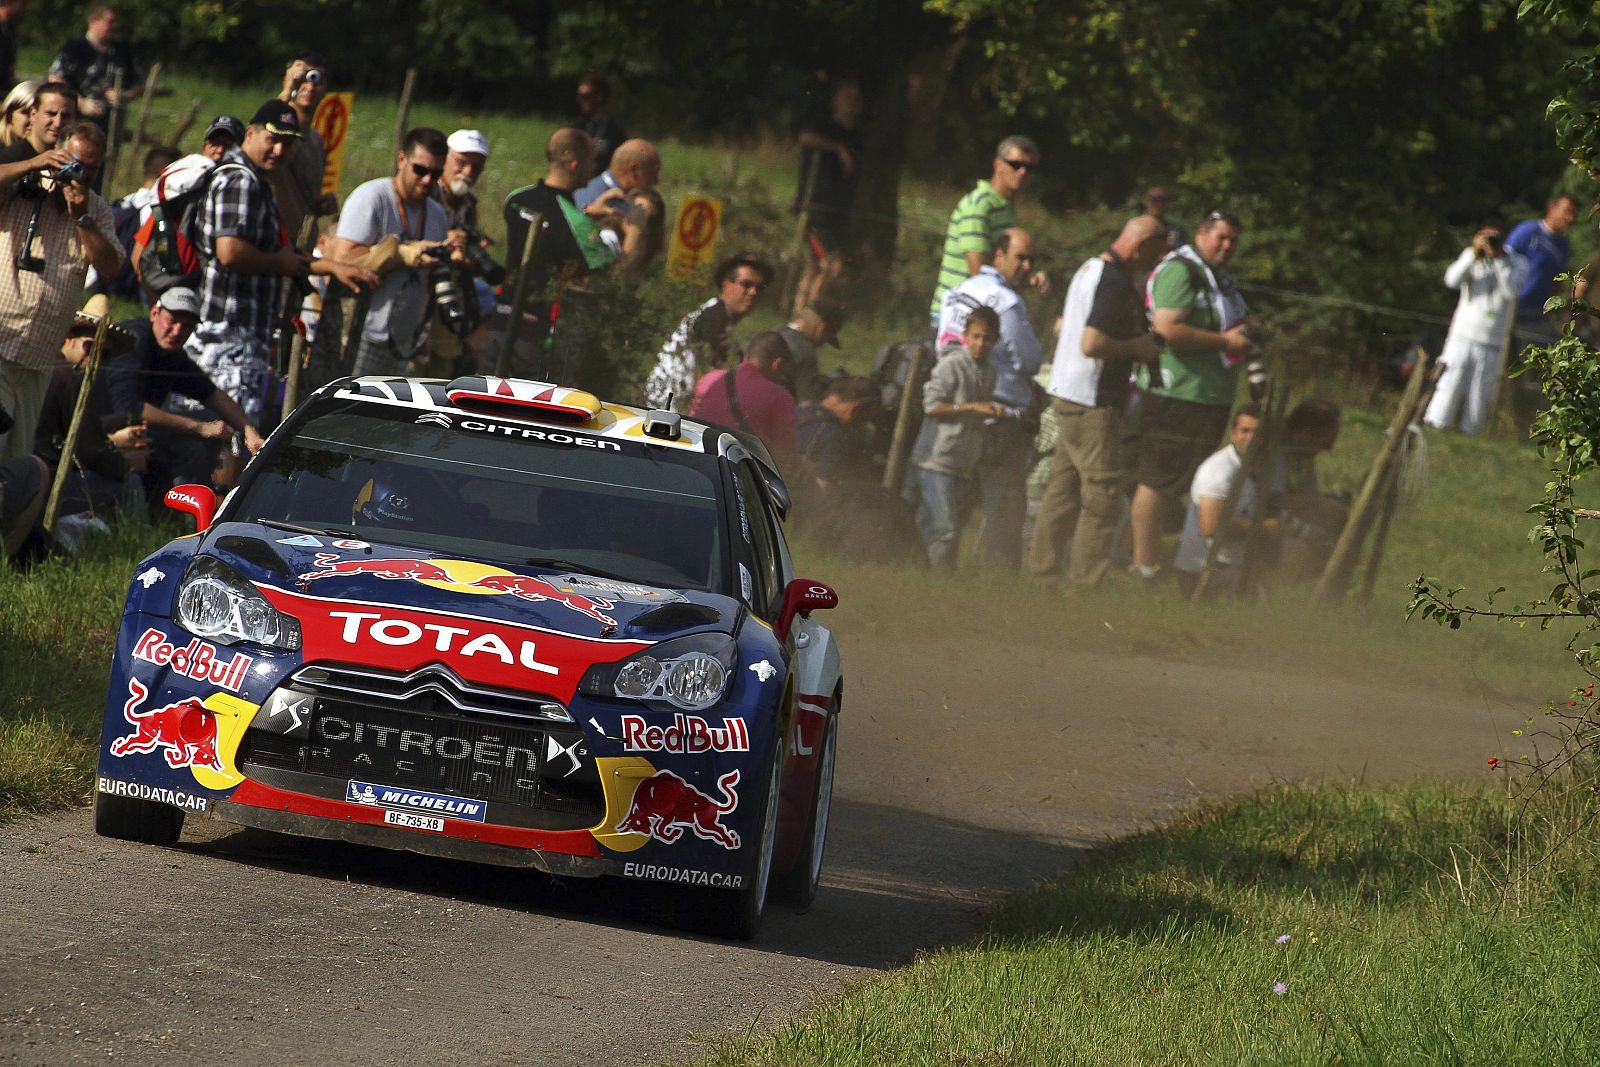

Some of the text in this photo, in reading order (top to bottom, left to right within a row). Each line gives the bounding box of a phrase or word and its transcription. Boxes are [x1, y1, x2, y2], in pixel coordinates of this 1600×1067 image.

[167, 490, 200, 508] TOTAL
[132, 629, 252, 691] Red Bull
[329, 611, 559, 675] TOTAL
[316, 716, 537, 772] CITROËN
[622, 714, 686, 754] Red
[687, 716, 749, 753] Bull
[98, 777, 207, 812] EURODATACAR
[381, 790, 480, 815] MICHELIN
[388, 812, 440, 830] BF-735-XB
[623, 862, 743, 889] EURODATACAR
